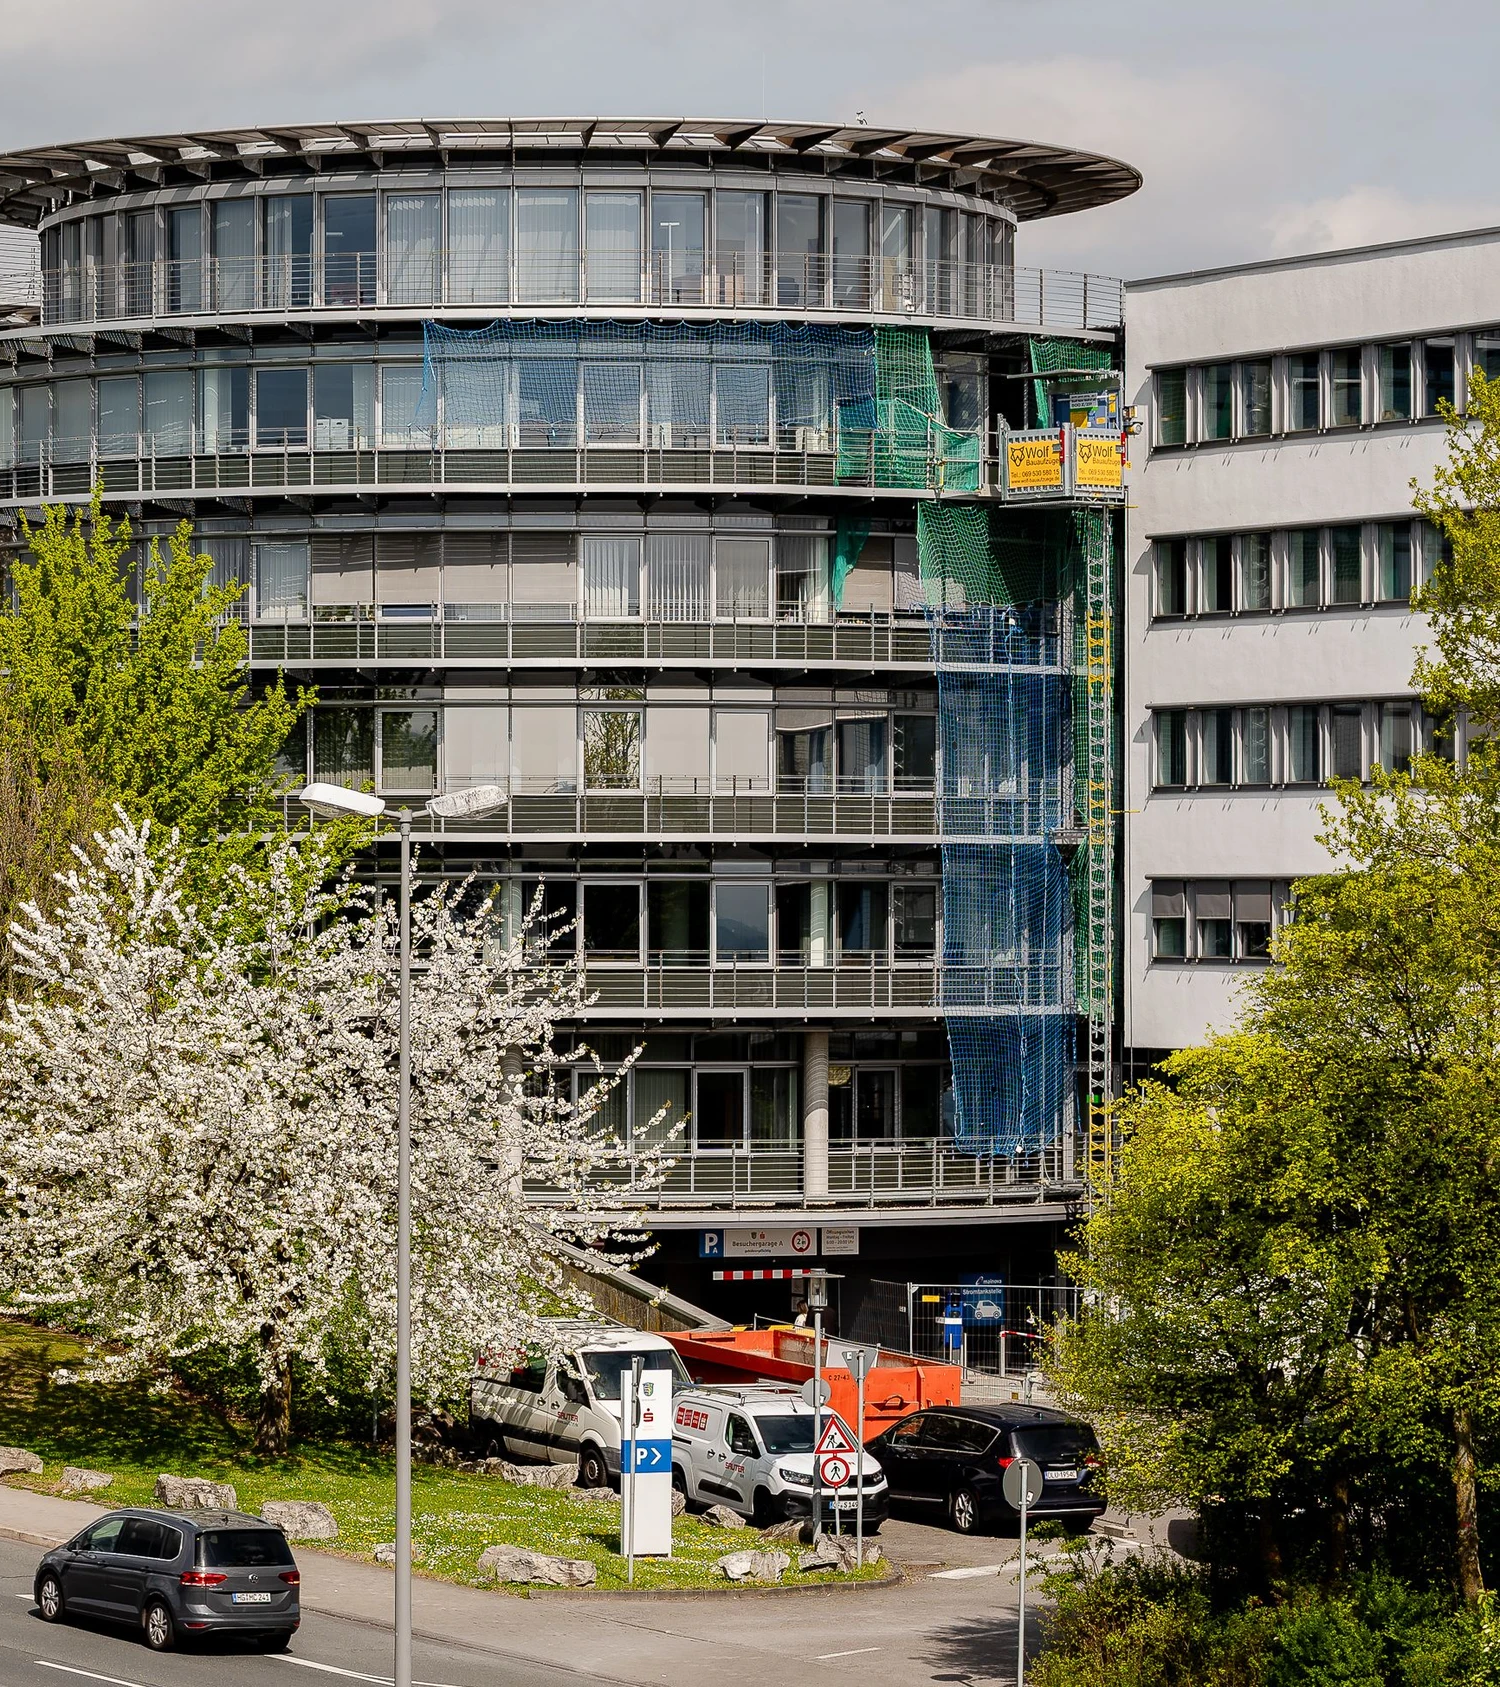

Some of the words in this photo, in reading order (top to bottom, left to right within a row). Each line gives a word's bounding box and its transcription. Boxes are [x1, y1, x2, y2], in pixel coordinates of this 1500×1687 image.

[1025, 446, 1049, 458] Wolf
[1093, 446, 1113, 458] Wolf
[705, 1233, 718, 1253] P
[962, 1288, 1002, 1296] Stromtankstelle
[557, 1411, 578, 1422] SAUTER
[636, 1447, 648, 1465] P
[725, 1461, 745, 1474] SAUTER
